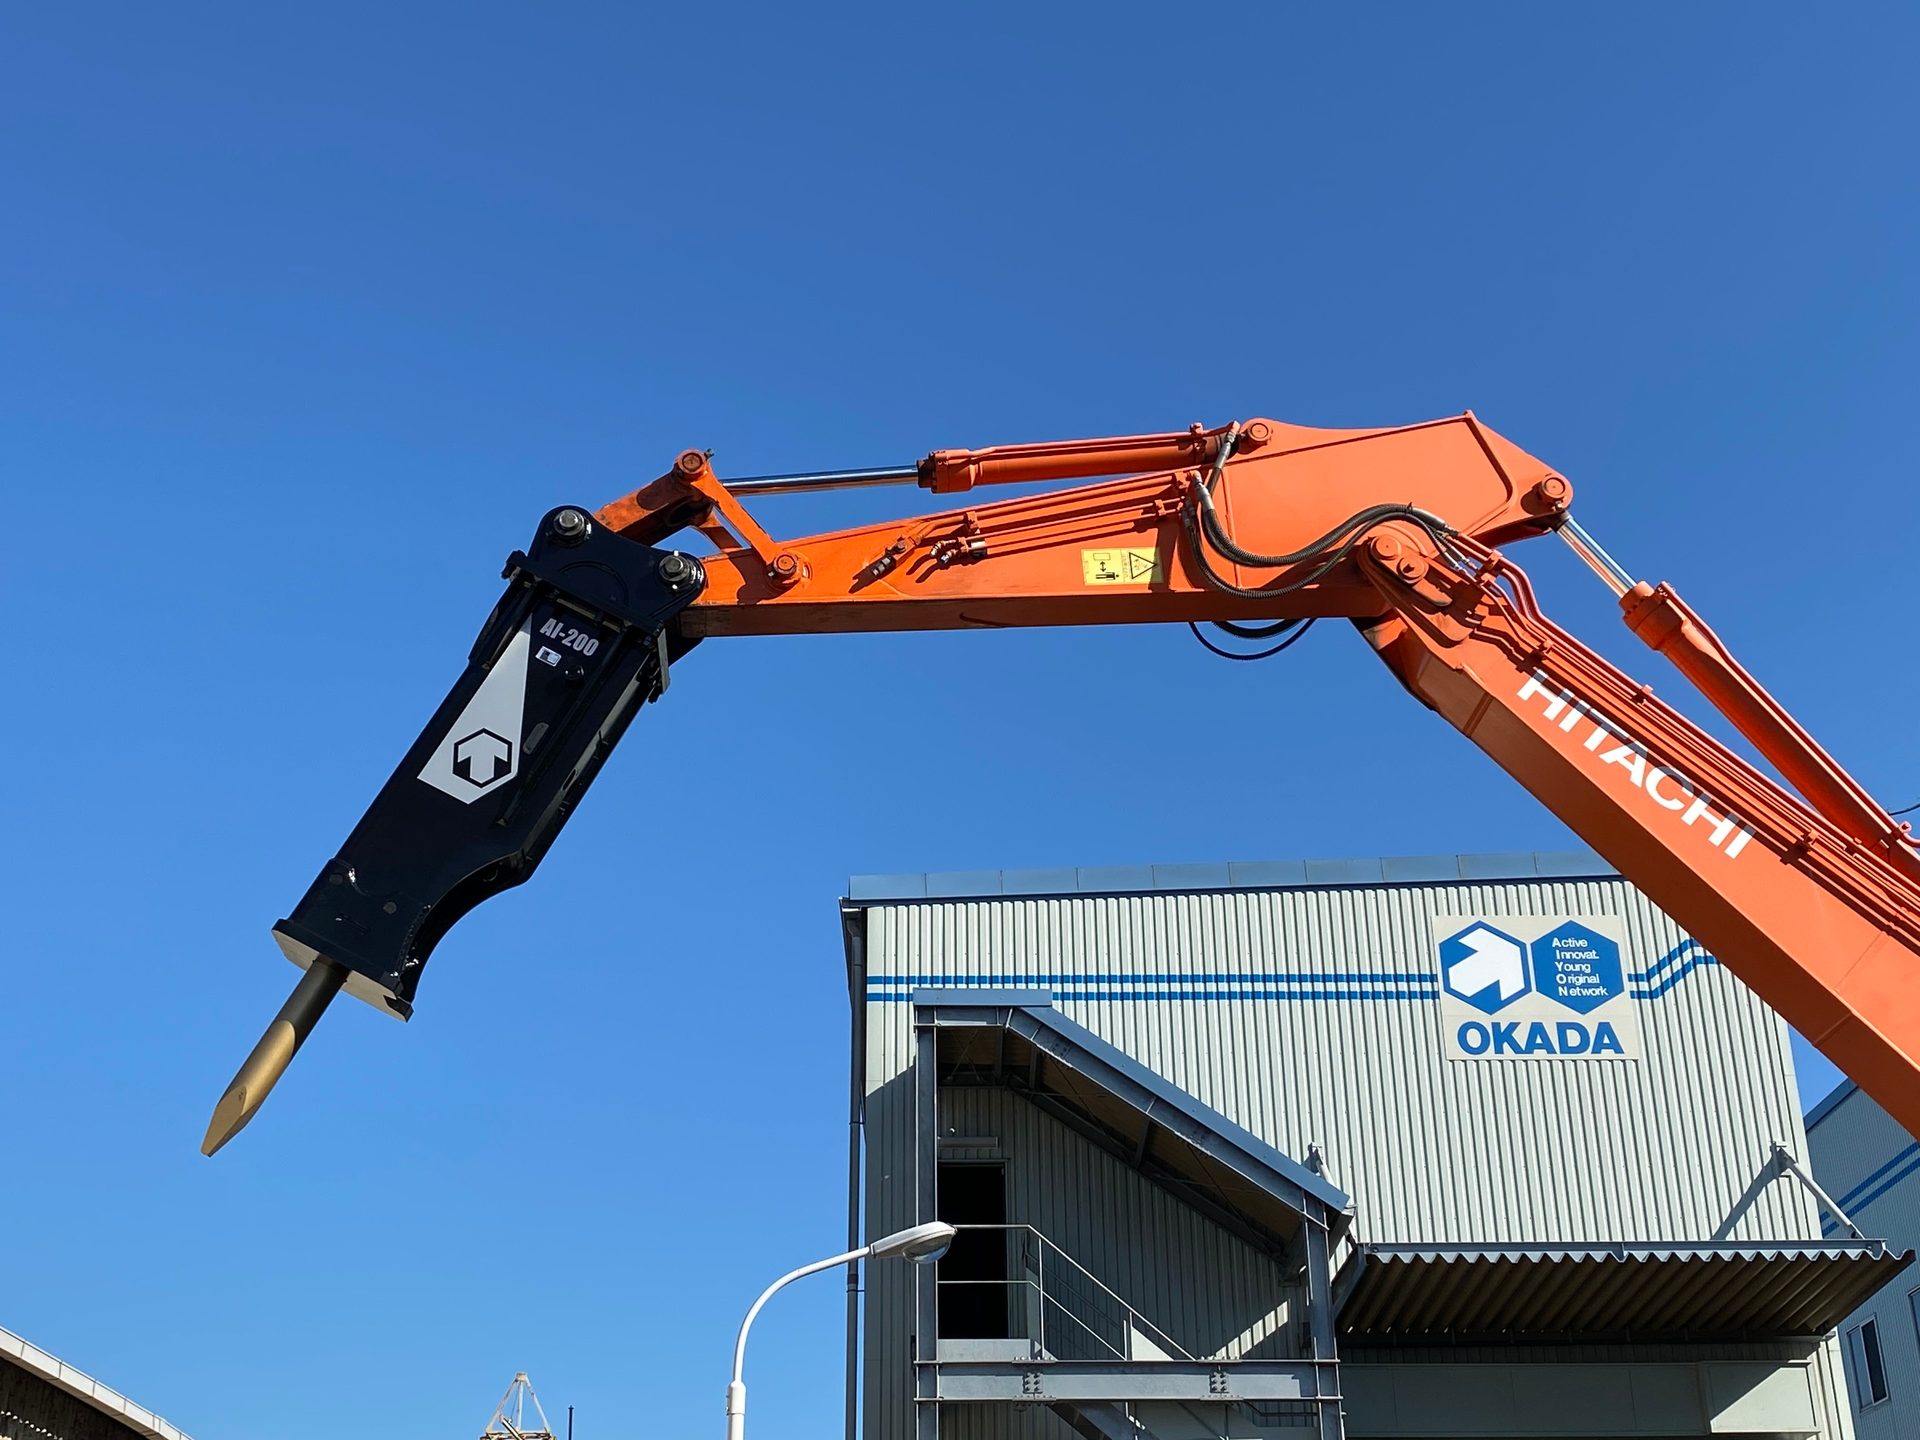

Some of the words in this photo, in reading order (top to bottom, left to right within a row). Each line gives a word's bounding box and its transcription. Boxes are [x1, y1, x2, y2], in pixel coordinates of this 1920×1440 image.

[539, 617, 600, 657] AI-200
[1517, 668, 1757, 860] HITACHI
[1552, 937, 1588, 948] Active
[1554, 961, 1592, 974] Young
[1556, 973, 1600, 986] Original
[1558, 985, 1609, 997] Network
[1457, 1020, 1625, 1056] OKADA
